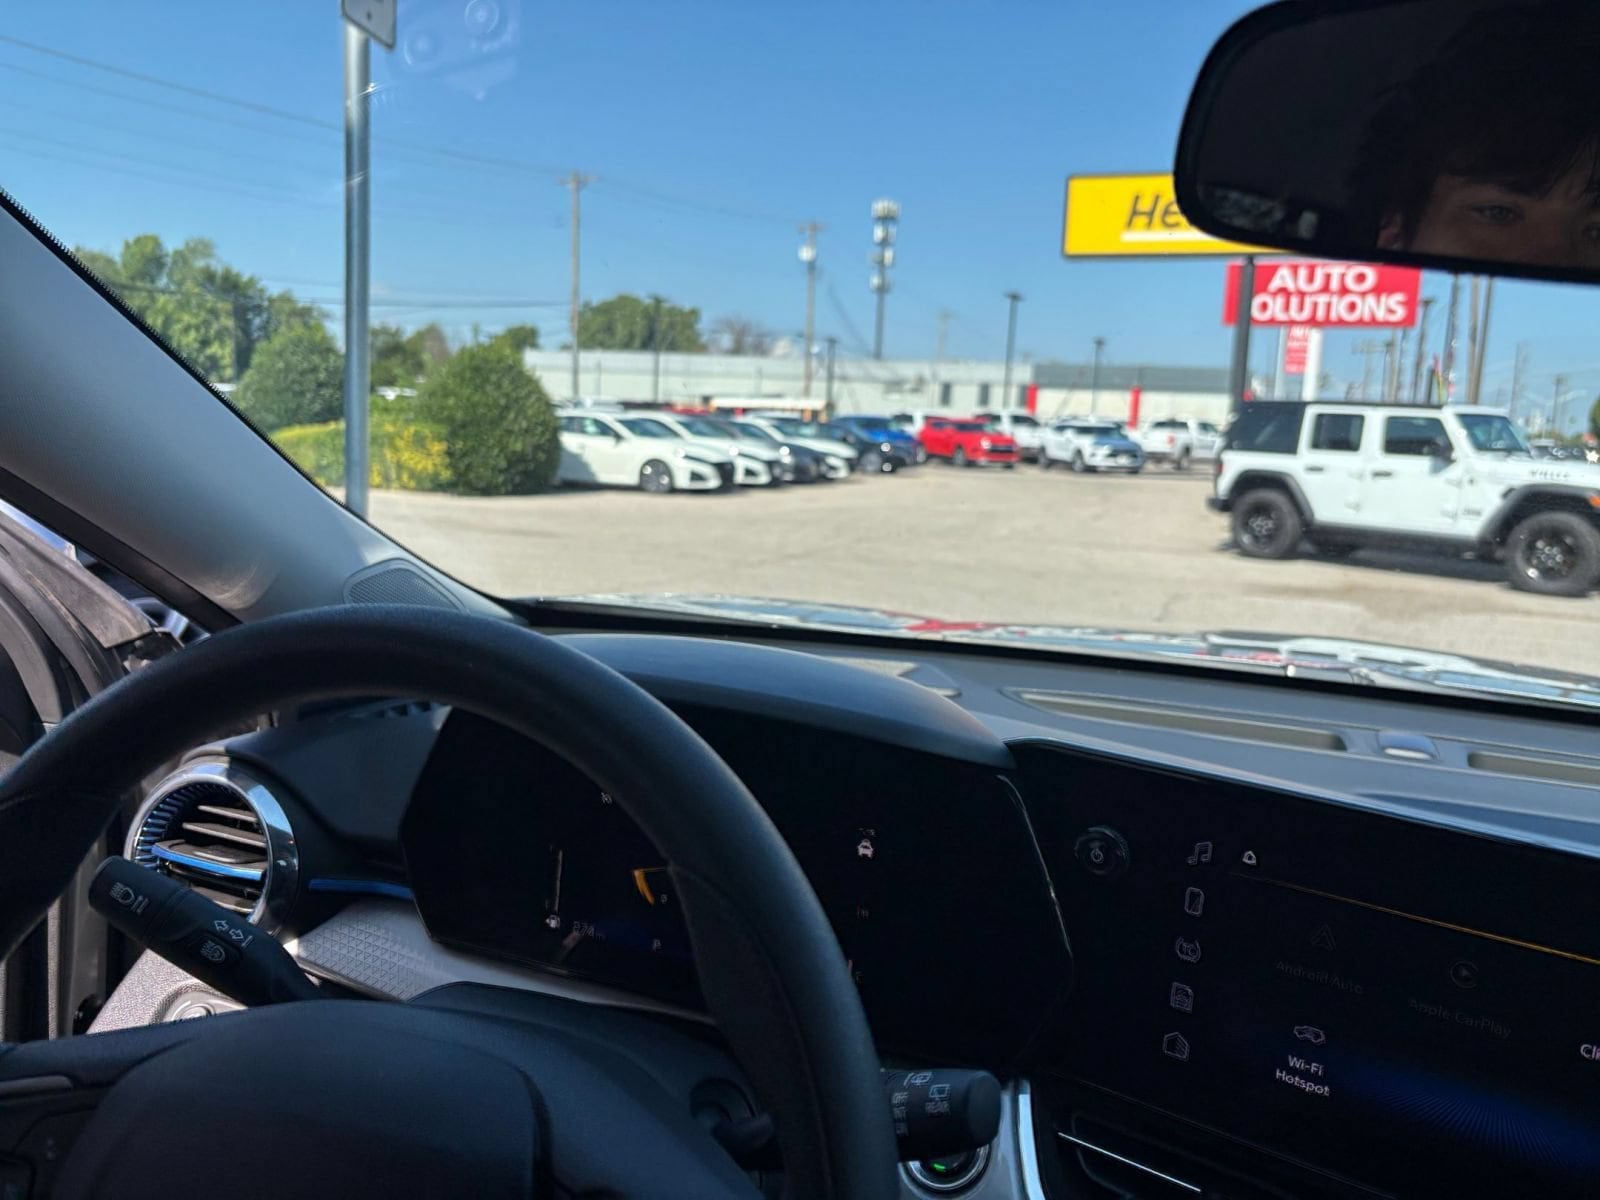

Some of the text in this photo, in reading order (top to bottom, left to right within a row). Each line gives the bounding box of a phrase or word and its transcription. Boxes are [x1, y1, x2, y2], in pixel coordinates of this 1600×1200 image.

[1267, 264, 1377, 293] AUTO
[1251, 292, 1407, 323] OLUTIONS
[1288, 1054, 1325, 1077] Wi-Fi
[1275, 1068, 1331, 1097] Hotspot
